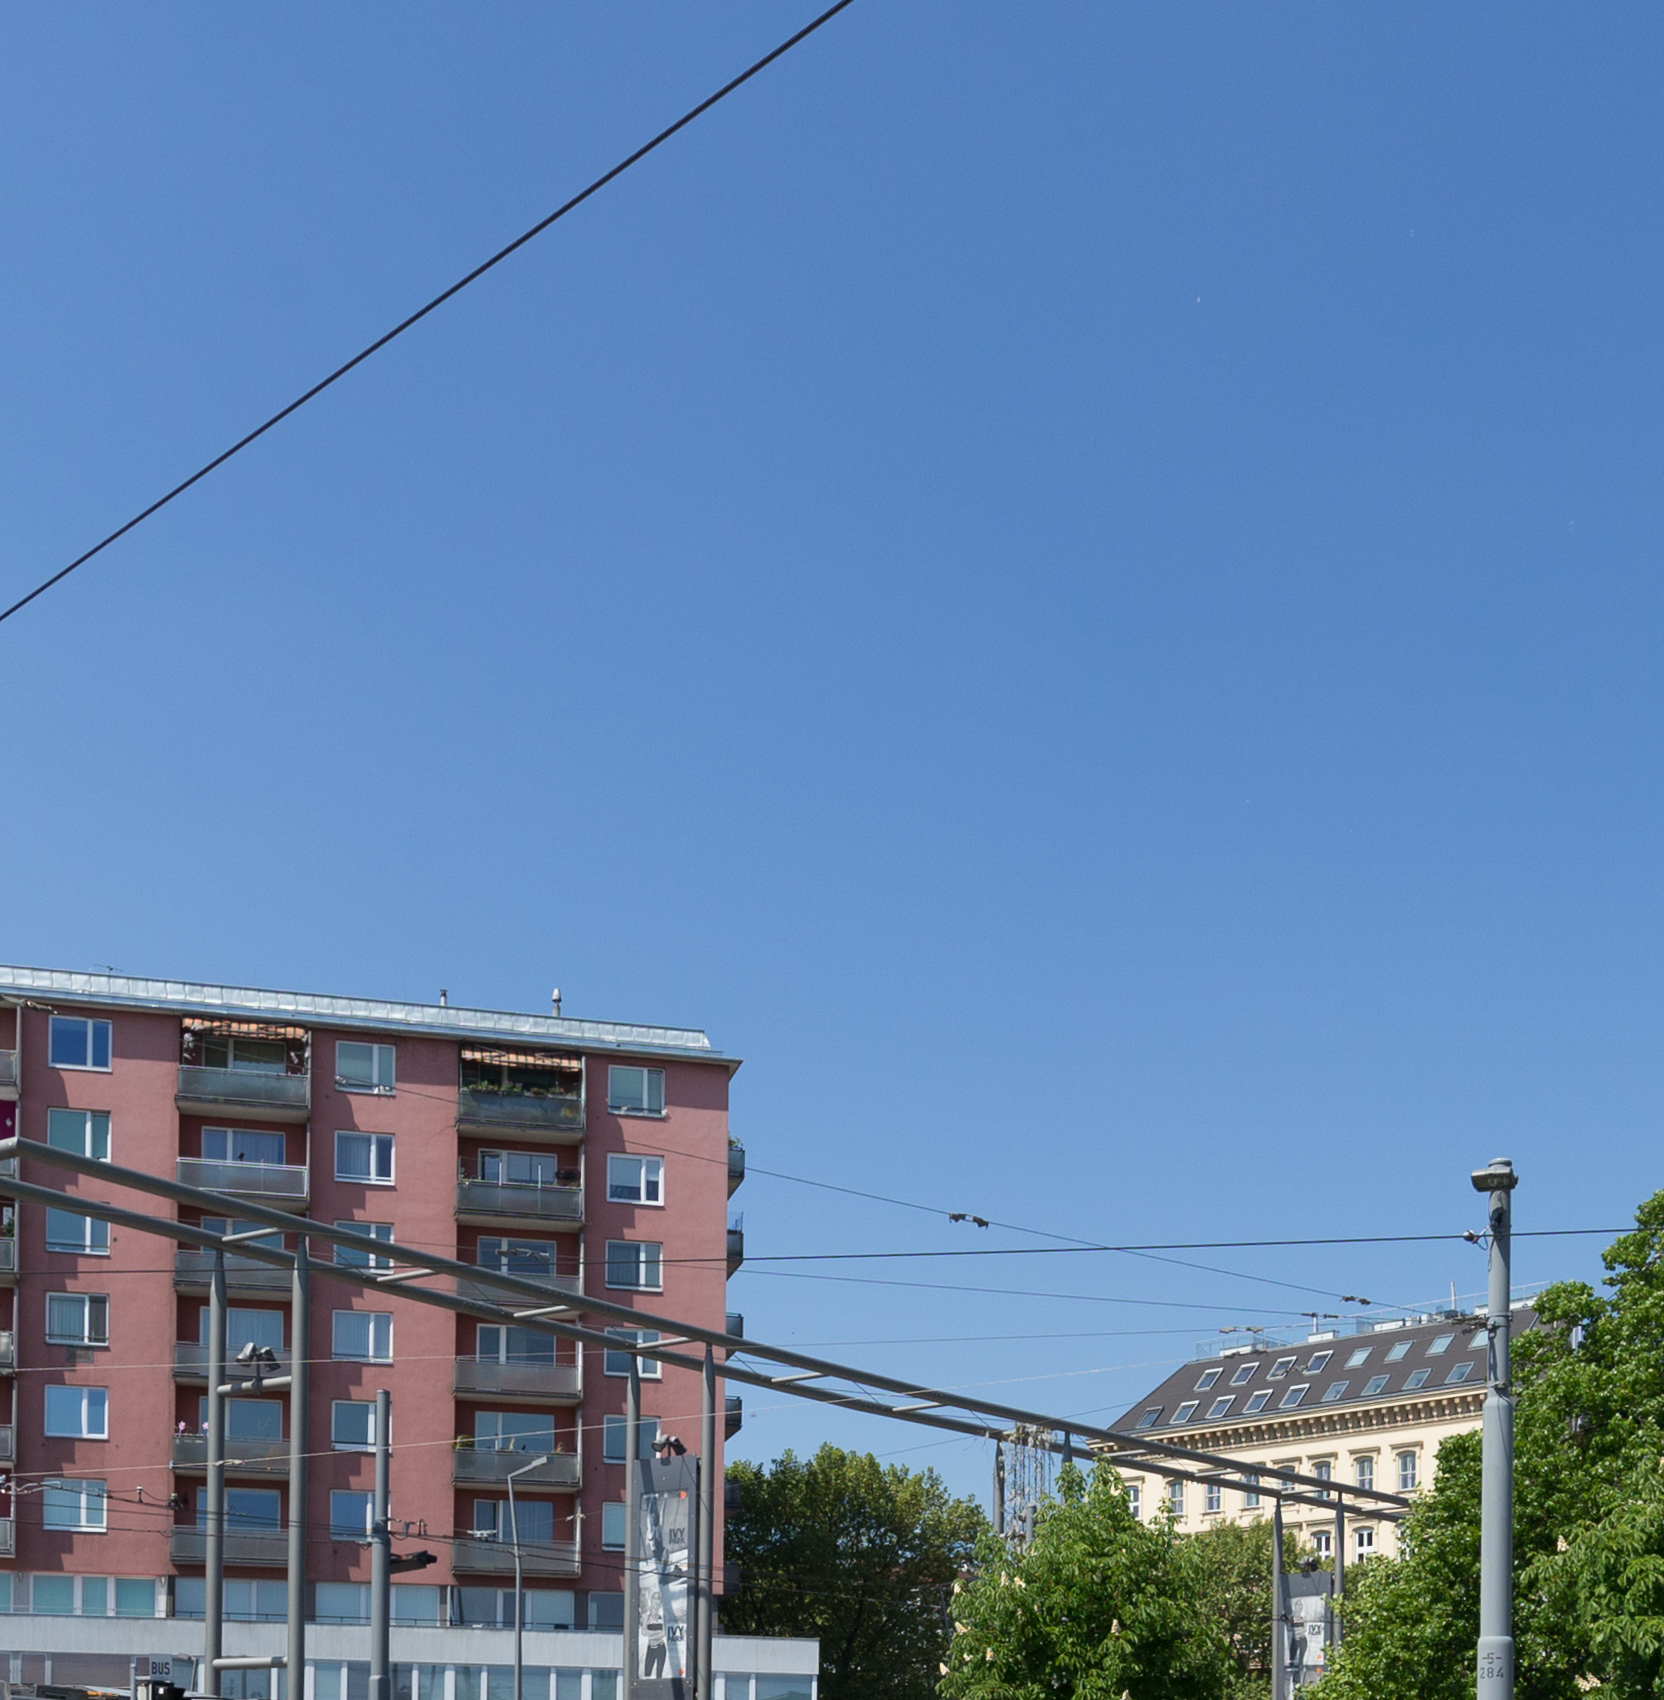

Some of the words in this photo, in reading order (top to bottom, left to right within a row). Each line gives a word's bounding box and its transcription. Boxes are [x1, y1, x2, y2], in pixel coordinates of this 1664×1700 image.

[669, 1527, 685, 1538] IVY
[667, 1625, 684, 1636] IVY
[151, 1661, 171, 1675] BUS
[1480, 1666, 1504, 1679] 284
